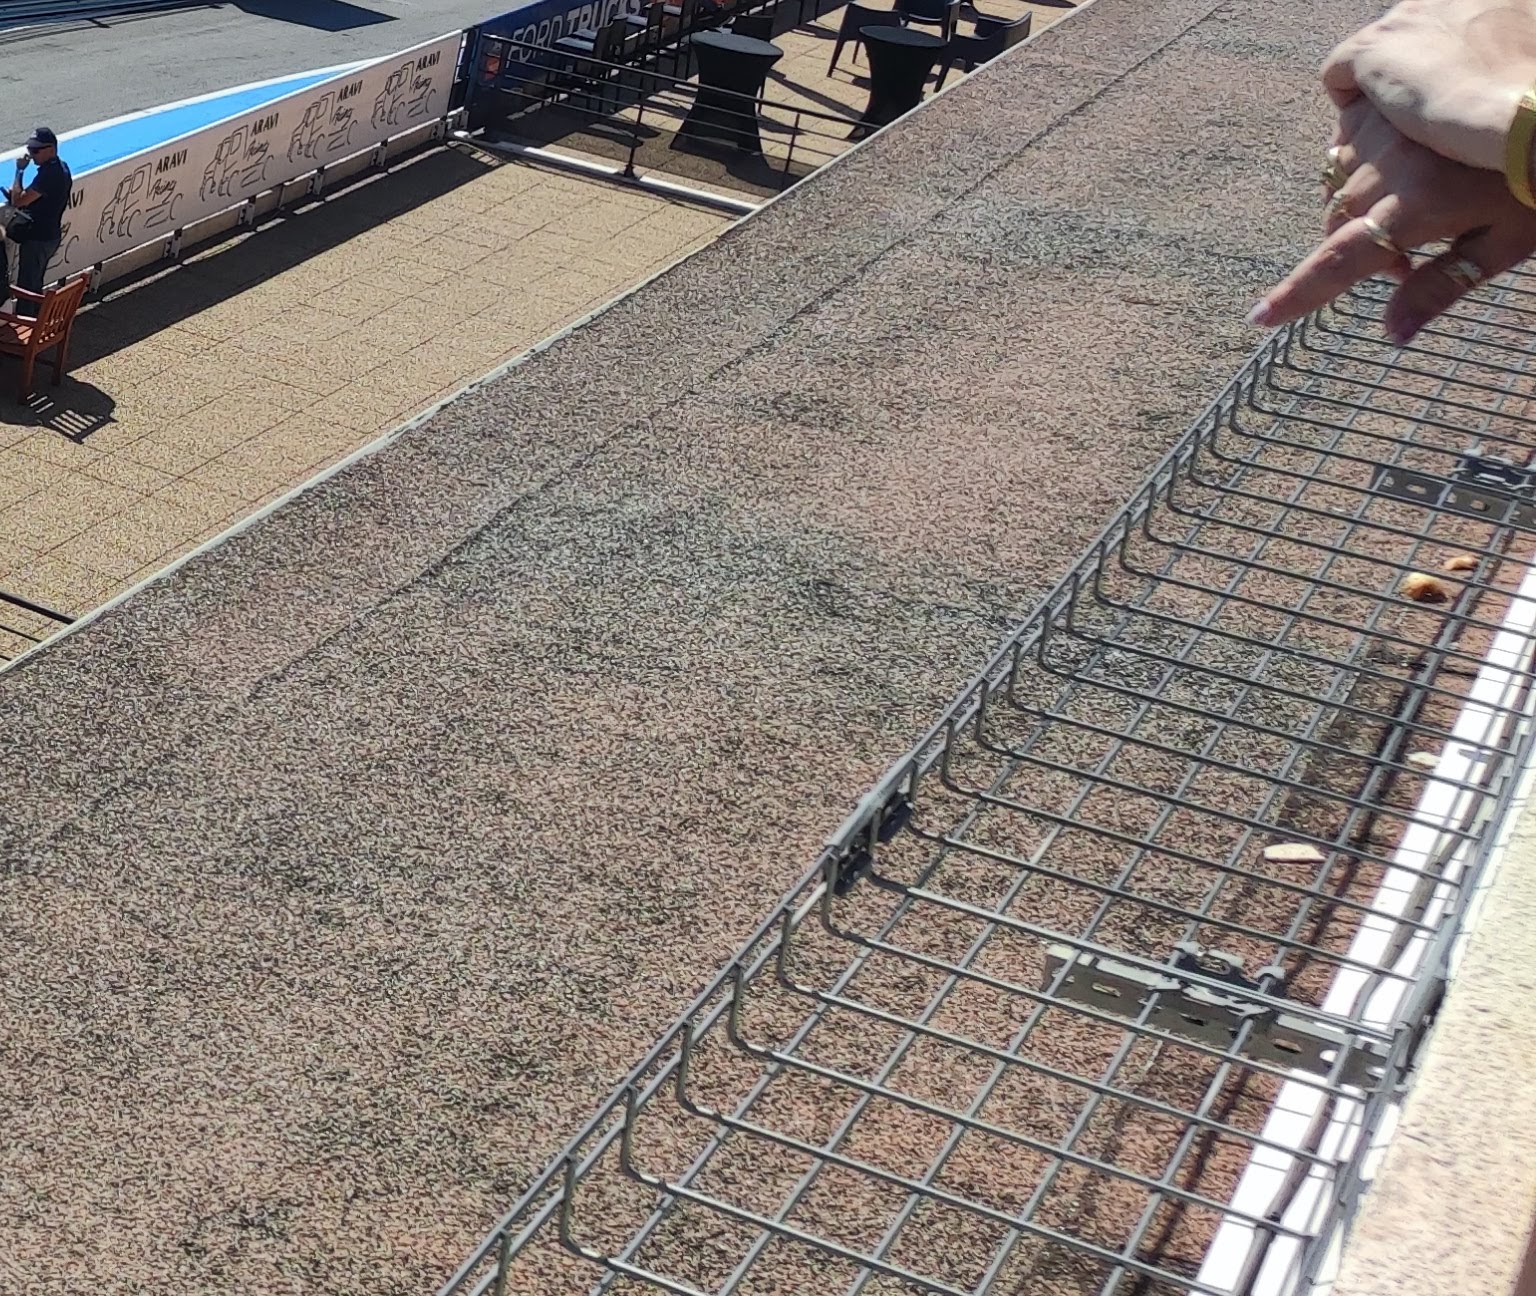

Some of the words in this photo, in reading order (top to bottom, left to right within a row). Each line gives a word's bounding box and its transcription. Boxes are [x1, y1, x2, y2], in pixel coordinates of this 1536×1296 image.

[506, 15, 563, 69] FORD
[415, 51, 441, 73] ARAVI
[336, 80, 363, 103] ARAVI
[251, 112, 279, 137] ARAVI
[155, 149, 188, 175] ARAVI
